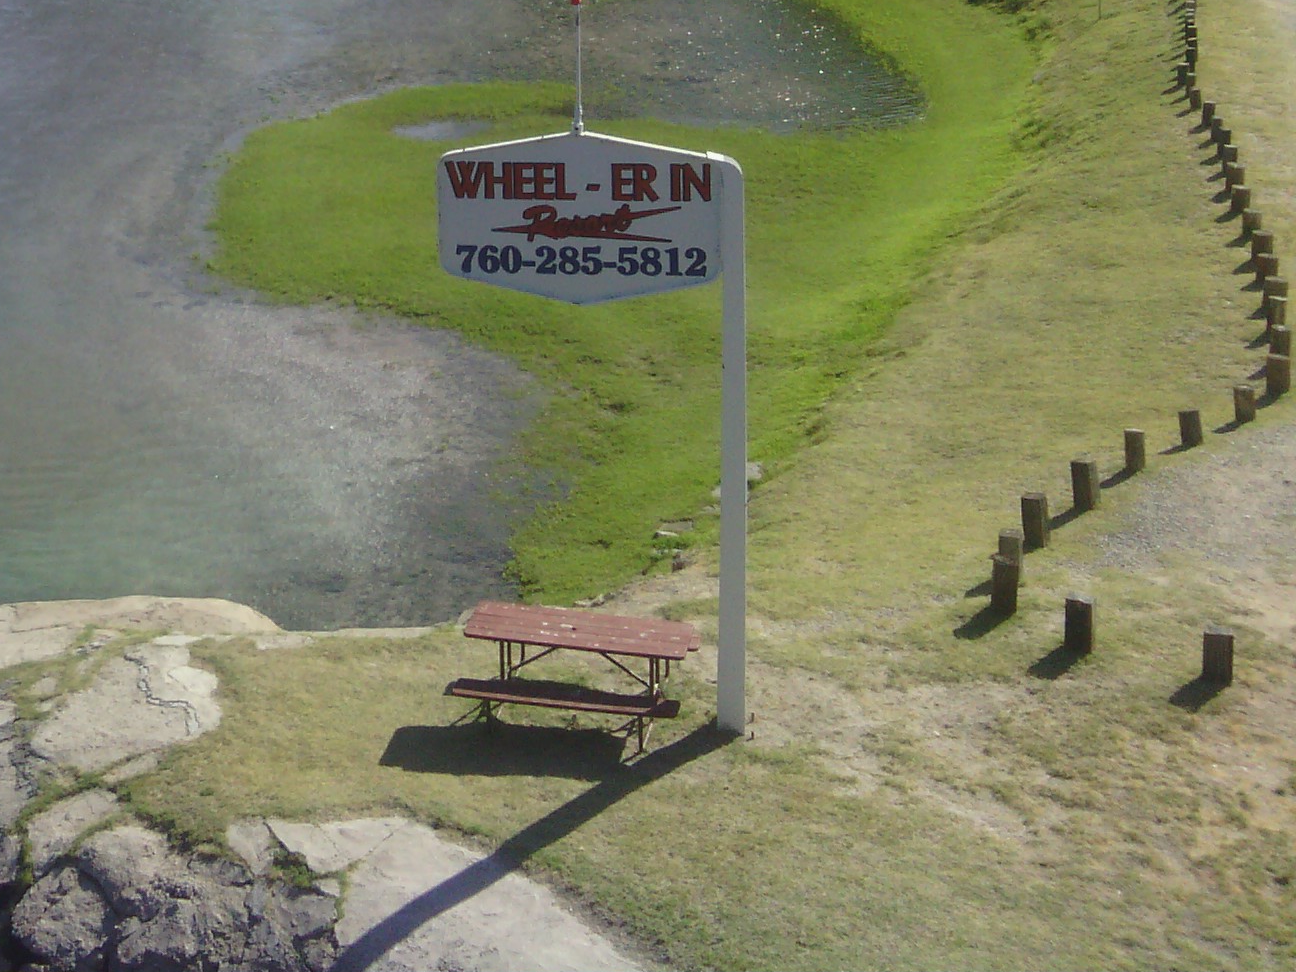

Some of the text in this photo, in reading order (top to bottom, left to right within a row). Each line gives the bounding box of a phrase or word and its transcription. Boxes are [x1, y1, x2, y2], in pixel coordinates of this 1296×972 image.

[445, 161, 577, 201] WHEEL
[611, 163, 659, 202] ER
[670, 163, 711, 202] IN
[456, 244, 707, 277] 760-285-5812
